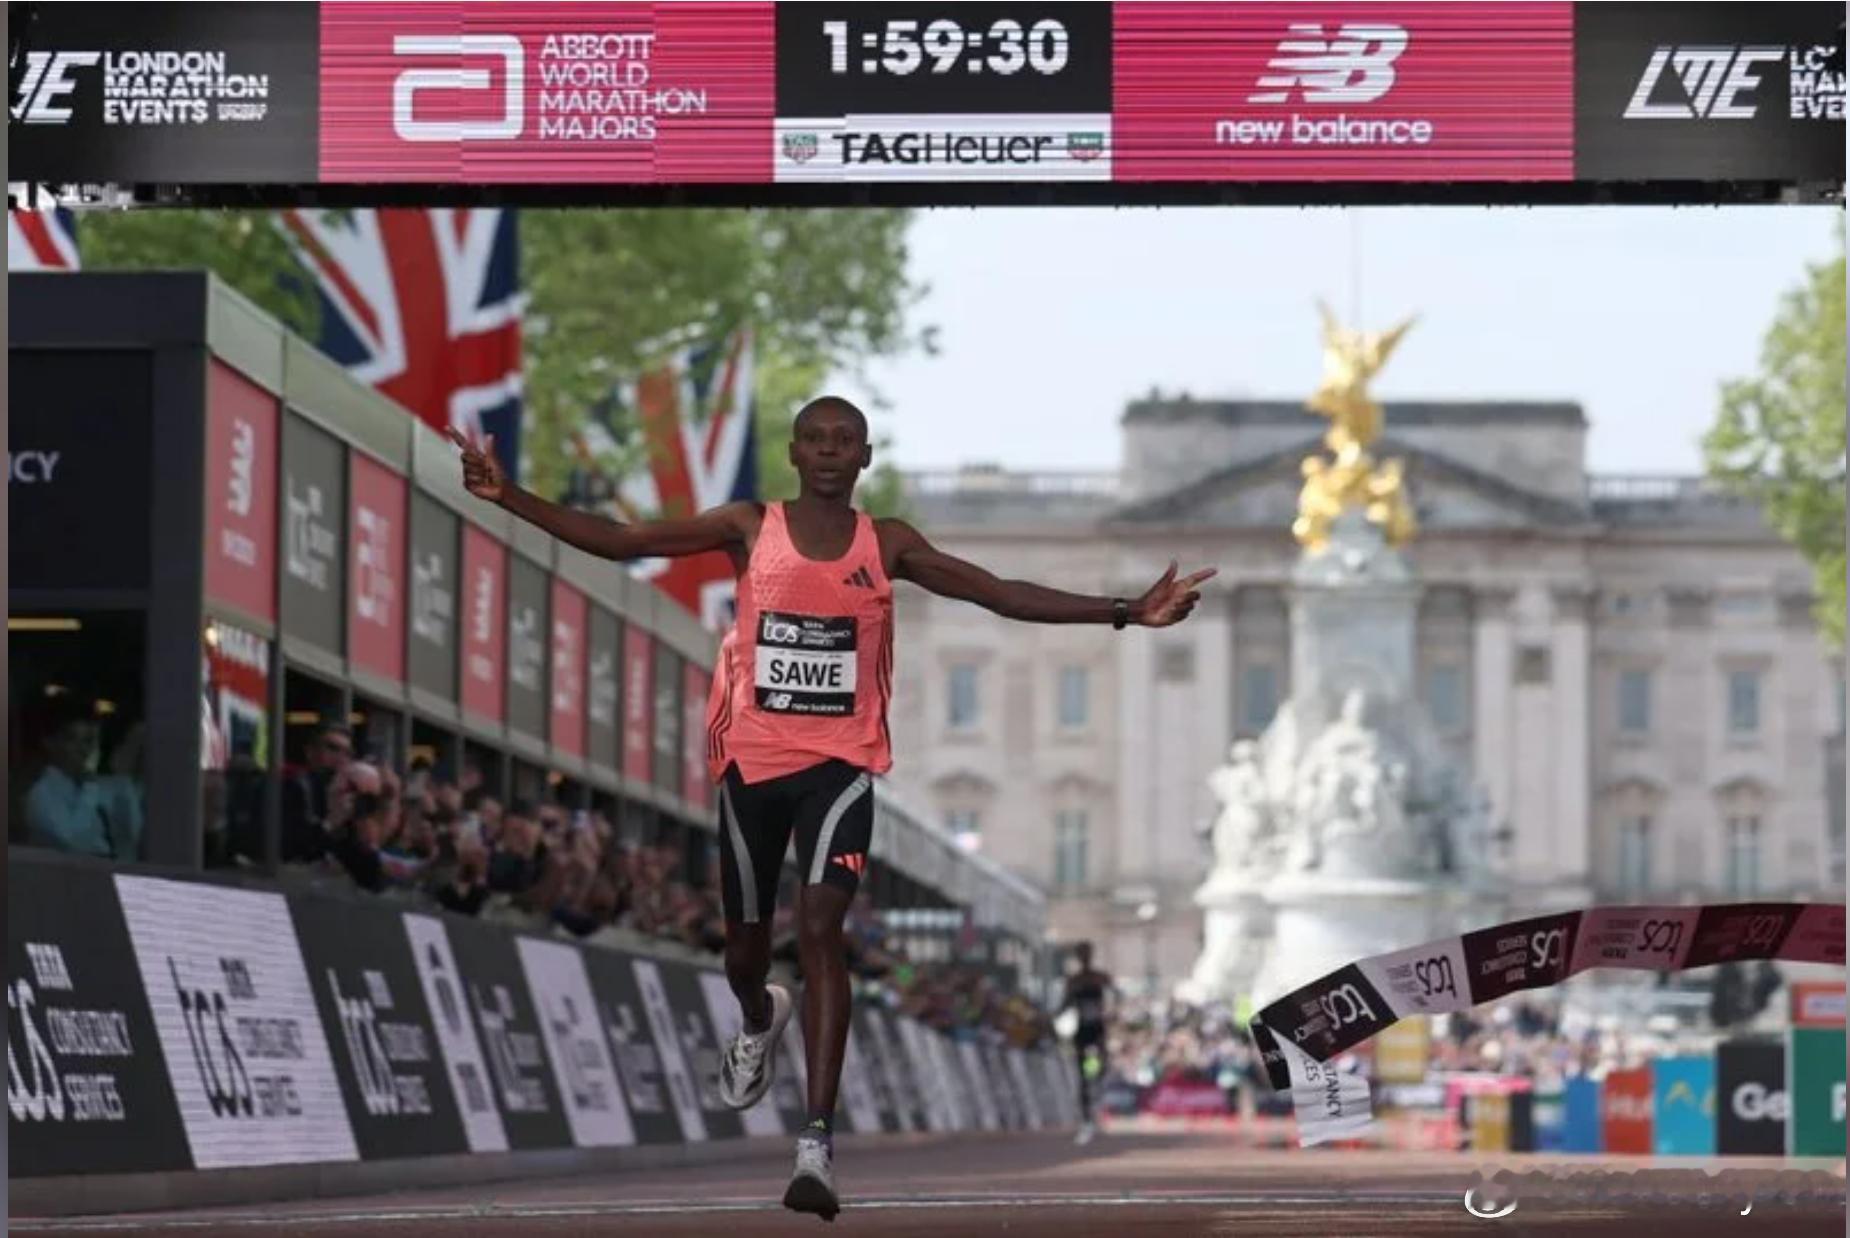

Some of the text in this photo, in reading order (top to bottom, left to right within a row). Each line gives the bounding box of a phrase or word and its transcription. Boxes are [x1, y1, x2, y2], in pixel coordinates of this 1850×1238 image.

[540, 34, 655, 59] ABBOTT
[823, 19, 1069, 75] 1:59:30
[104, 51, 225, 74] LONDON
[104, 75, 269, 97] MARATHON
[539, 63, 649, 87] WORLD
[104, 99, 208, 123] EVENTS
[540, 90, 706, 114] MARATHON
[540, 116, 656, 140] MAJORS
[1216, 115, 1433, 143] new balance
[769, 658, 843, 688] SAWE
